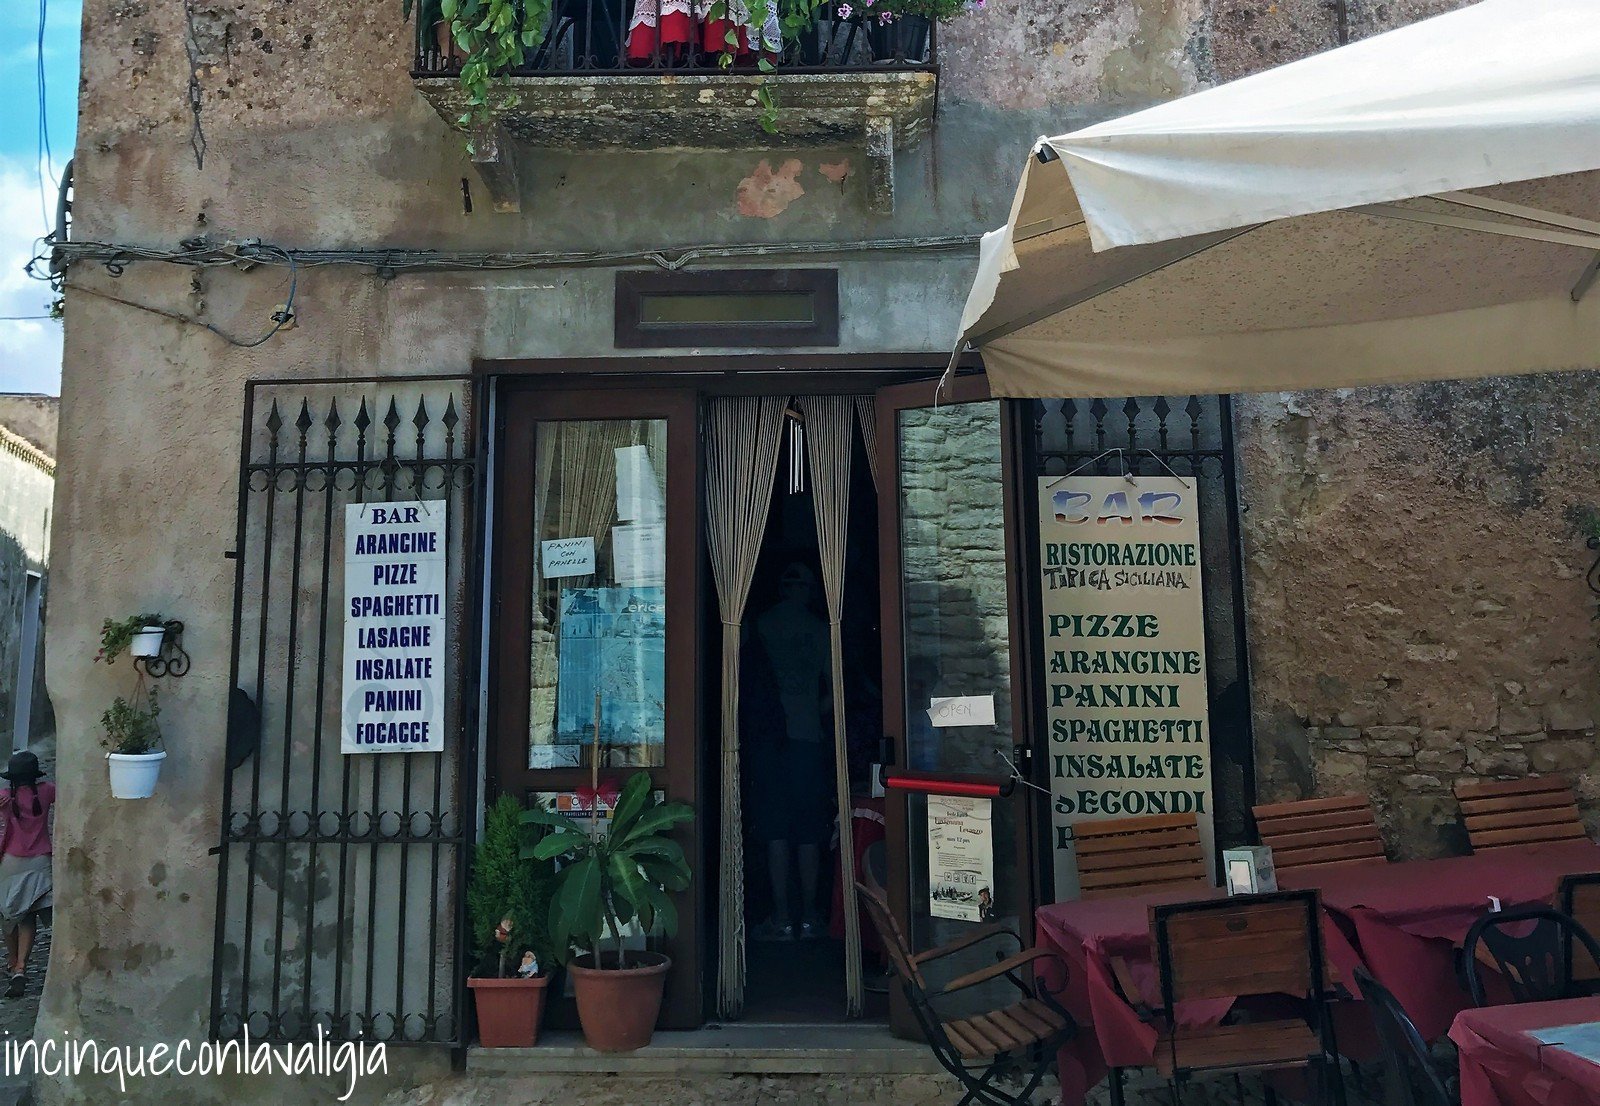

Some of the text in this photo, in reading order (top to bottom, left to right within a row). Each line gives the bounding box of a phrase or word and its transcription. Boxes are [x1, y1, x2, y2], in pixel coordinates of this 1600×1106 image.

[371, 507, 420, 525] BAR
[1052, 490, 1184, 525] BAR
[355, 532, 437, 555] ARANCINE
[546, 540, 587, 551] PANINI
[560, 550, 577, 558] CON
[1045, 543, 1197, 567] RISTORAZIONE
[373, 563, 417, 586] PIZZE
[548, 557, 588, 569] PANELLE
[1114, 569, 1190, 590] SICILIANA
[351, 593, 439, 618] SPAGHETTI
[628, 602, 665, 613] erice
[358, 625, 431, 649] LASAGNE
[1049, 614, 1160, 638] PIZZE
[356, 657, 432, 681] INSALATE
[1050, 650, 1202, 675] ARANCINE
[364, 689, 422, 712] PANINI
[1051, 684, 1181, 708] PANINI
[938, 703, 972, 718] OPEN
[356, 721, 429, 745] FOCACCE
[1052, 718, 1204, 743] SPAGHETTI
[1053, 754, 1204, 779] INSALATE
[1055, 790, 1206, 815] SECONDI
